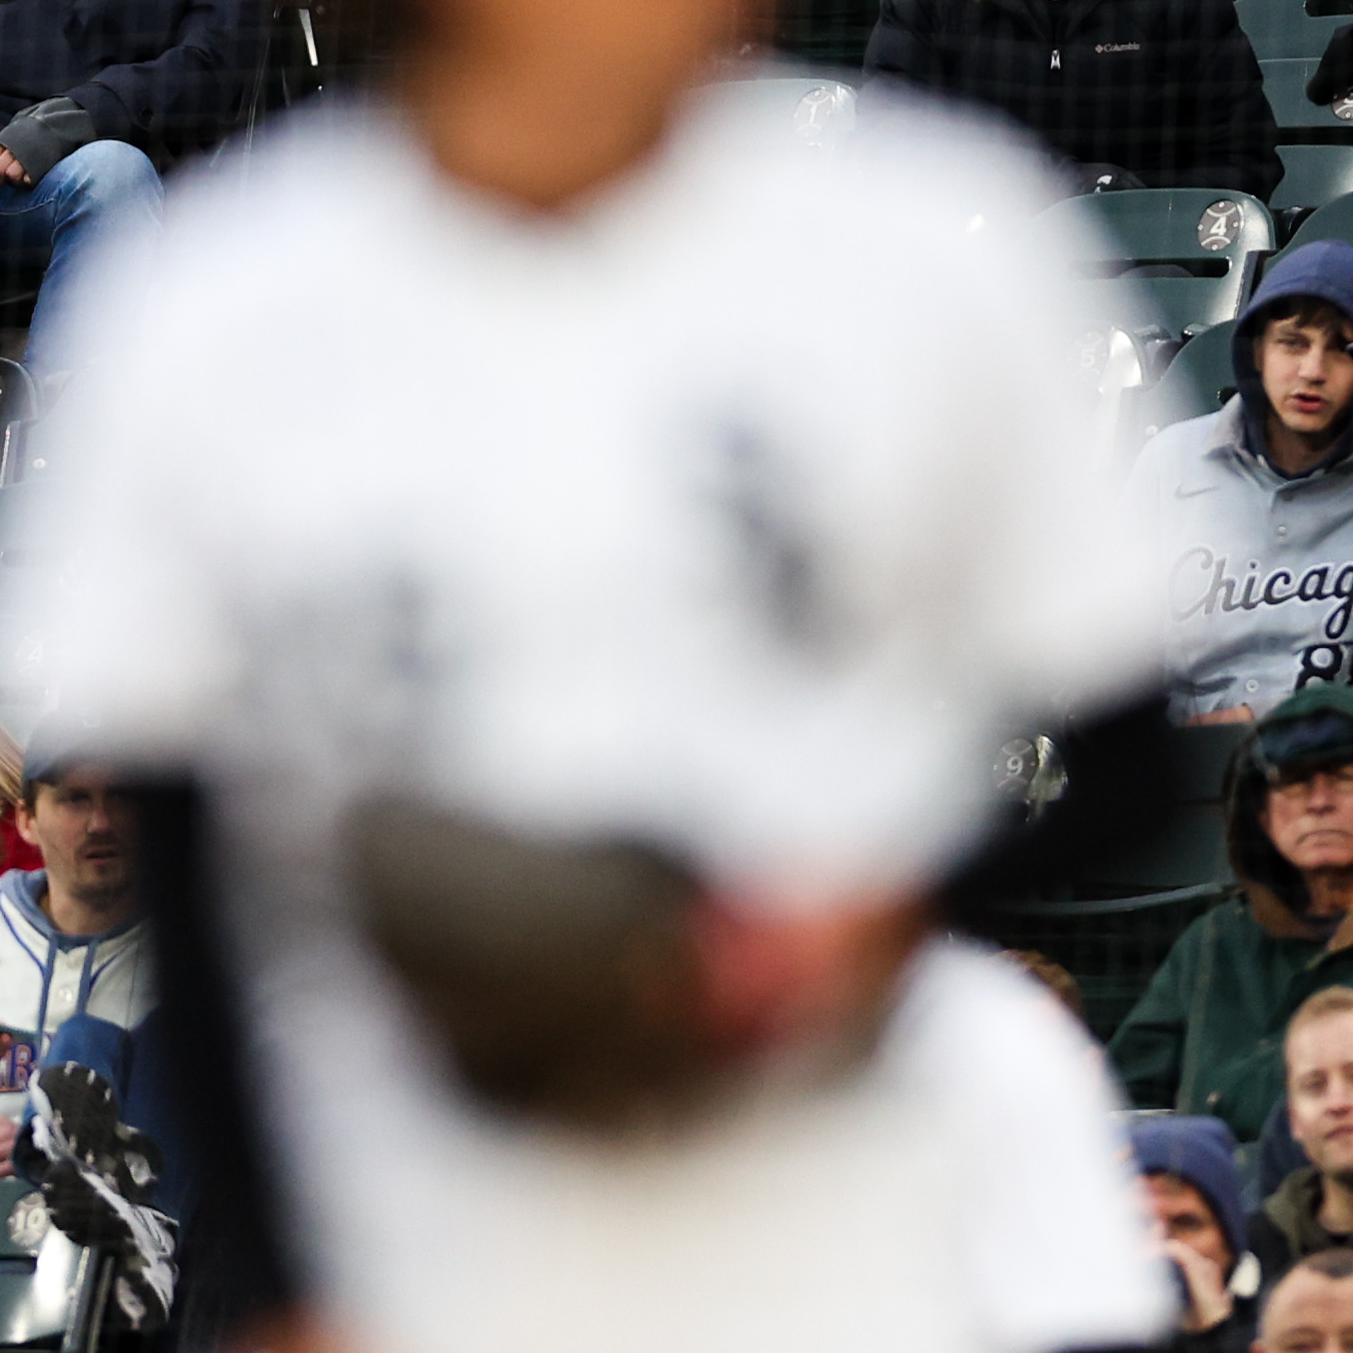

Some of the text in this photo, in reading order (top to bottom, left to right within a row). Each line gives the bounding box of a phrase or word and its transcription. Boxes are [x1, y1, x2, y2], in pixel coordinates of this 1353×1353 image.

[1104, 42, 1140, 53] Columbia
[1211, 217, 1226, 235] 4
[1006, 756, 1022, 775] 9
